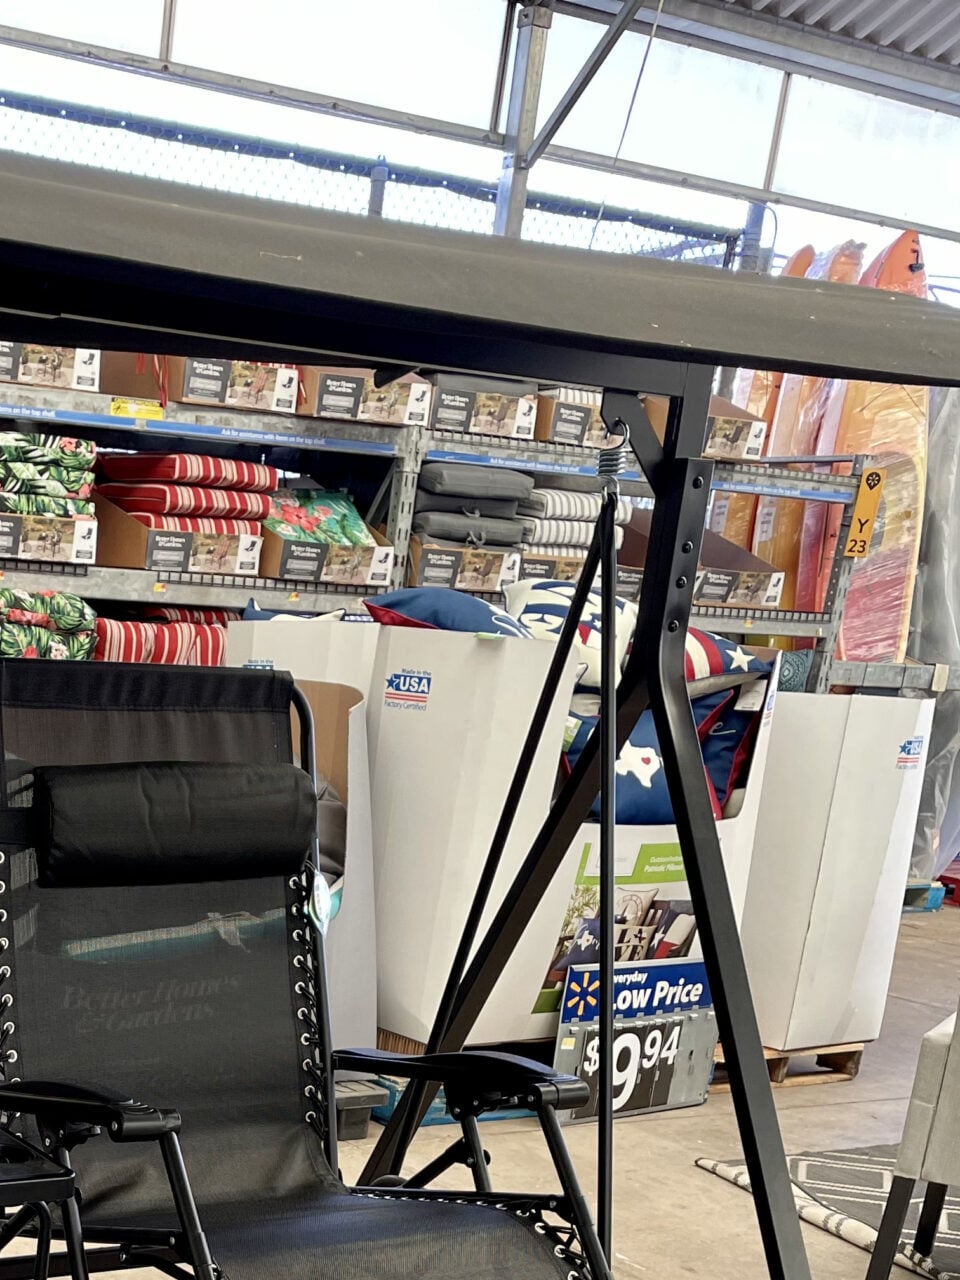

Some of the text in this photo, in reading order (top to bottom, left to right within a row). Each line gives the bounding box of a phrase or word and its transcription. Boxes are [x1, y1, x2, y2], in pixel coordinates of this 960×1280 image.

[857, 518, 869, 534] Y
[847, 539, 867, 554] 23
[400, 676, 429, 692] USA
[613, 971, 648, 986] veryday
[613, 978, 704, 1011] ow Price
